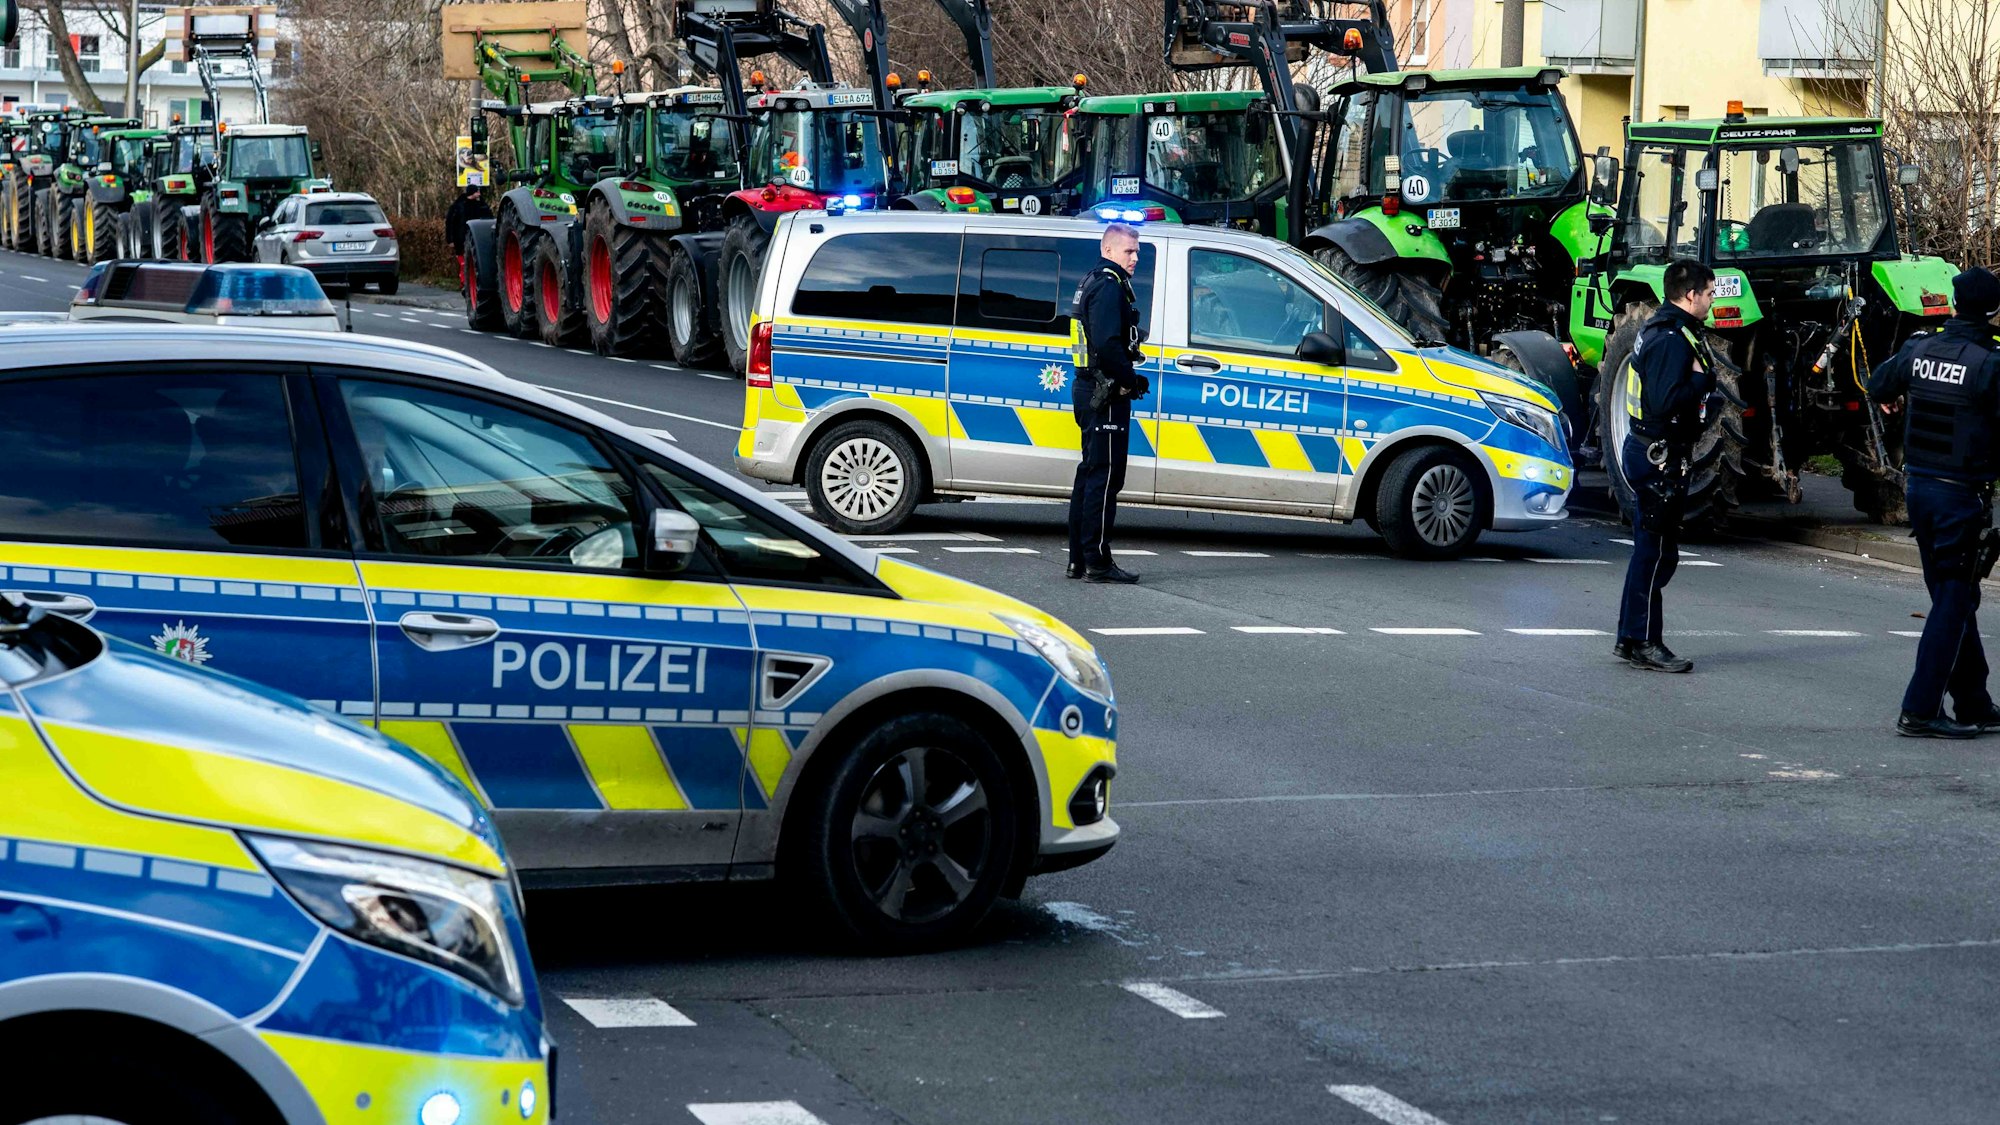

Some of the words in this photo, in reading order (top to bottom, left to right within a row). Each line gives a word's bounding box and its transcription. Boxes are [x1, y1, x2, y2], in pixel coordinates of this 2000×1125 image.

[688, 95, 698, 103] EU
[702, 94, 712, 102] MH
[713, 93, 724, 101] 46
[834, 95, 844, 104] EU
[849, 95, 855, 103] A
[856, 94, 873, 103] 671
[1155, 122, 1169, 137] 40
[1720, 129, 1796, 139] DEUTZ-FAHR
[794, 169, 806, 182] 40
[1408, 179, 1424, 196] 40
[657, 193, 668, 201] 40
[1025, 199, 1037, 213] 40
[1435, 210, 1445, 219] EU
[1431, 219, 1436, 227] B
[1438, 218, 1458, 227] 3012
[1721, 286, 1738, 297] 390
[1595, 319, 1604, 329] DX
[1604, 320, 1610, 330] 3
[1912, 357, 1967, 384] POLIZEI
[1200, 382, 1309, 414] POLIZEI
[491, 641, 708, 694] POLIZEI
